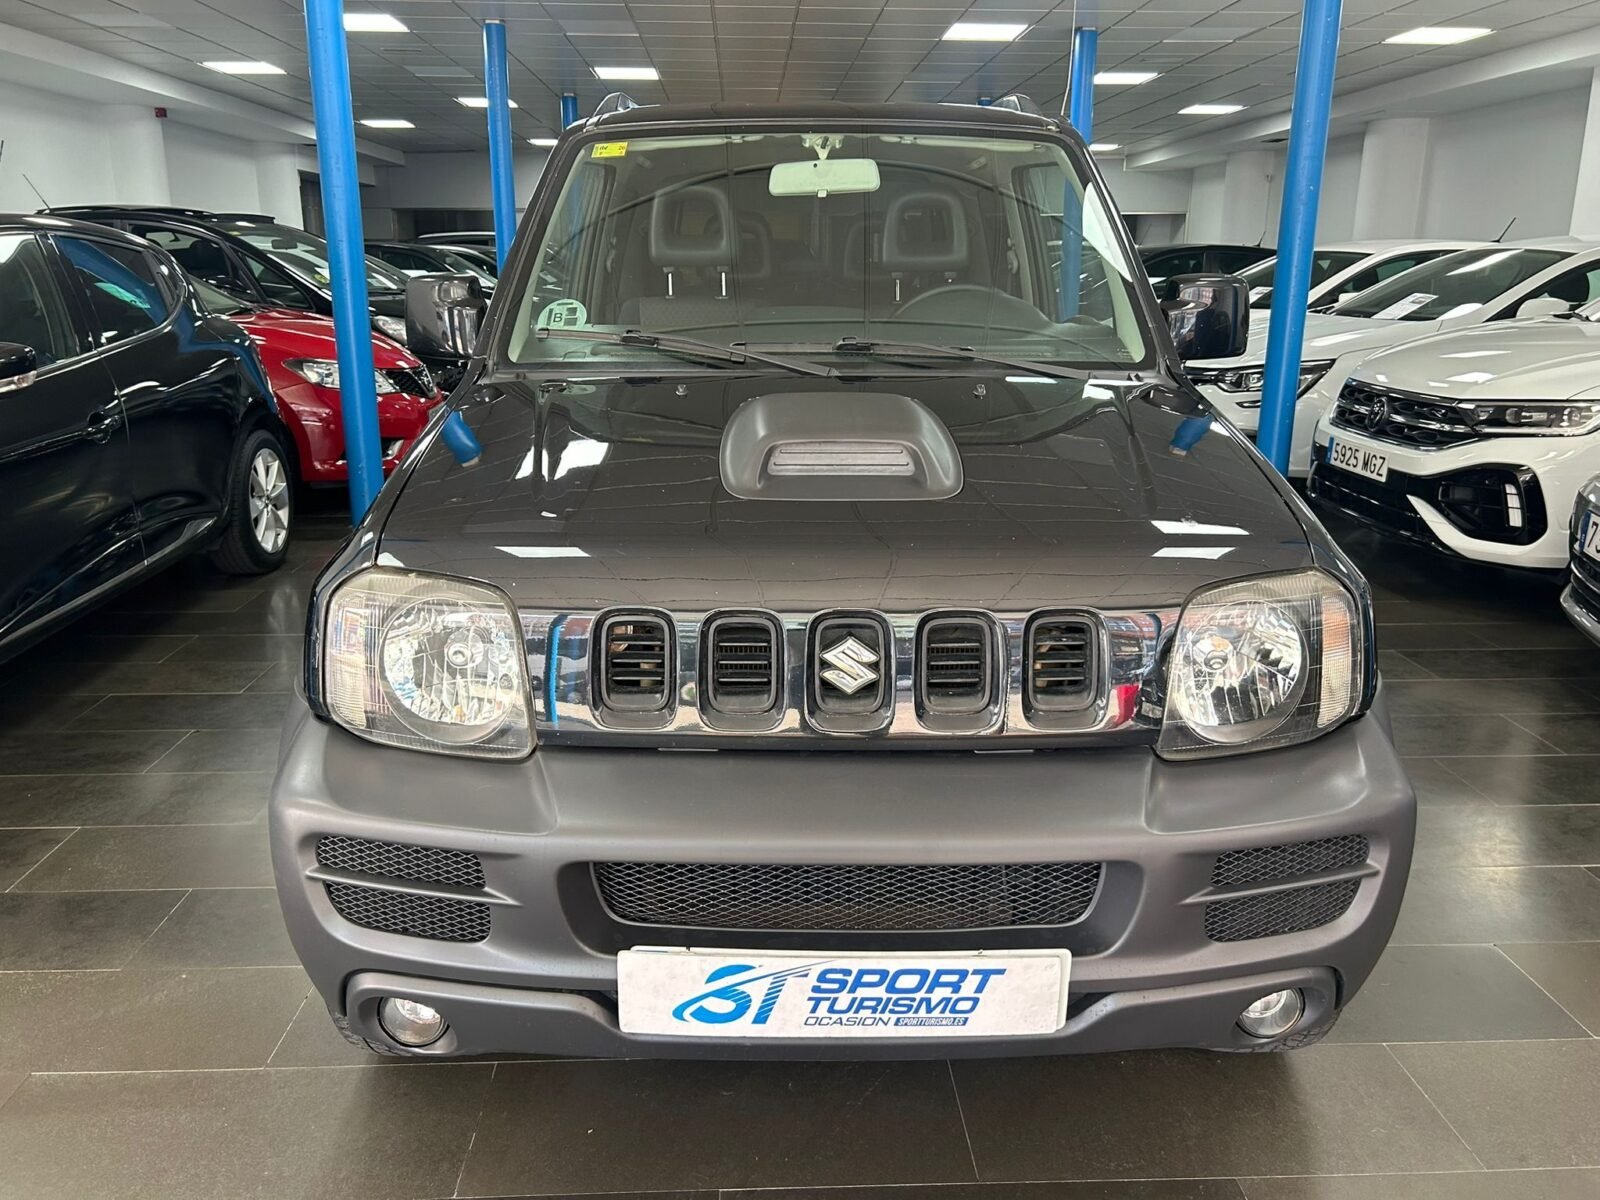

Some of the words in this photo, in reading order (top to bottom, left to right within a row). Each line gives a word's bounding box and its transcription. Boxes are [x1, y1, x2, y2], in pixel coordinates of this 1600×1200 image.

[553, 312, 563, 323] B
[1333, 442, 1360, 468] 5925
[1361, 450, 1387, 478] MGZ
[811, 967, 1008, 995] SPORT
[806, 996, 981, 1015] TURISMO
[803, 1016, 891, 1027] OCASION
[896, 1016, 966, 1027] SPORTTURISMO.ES
